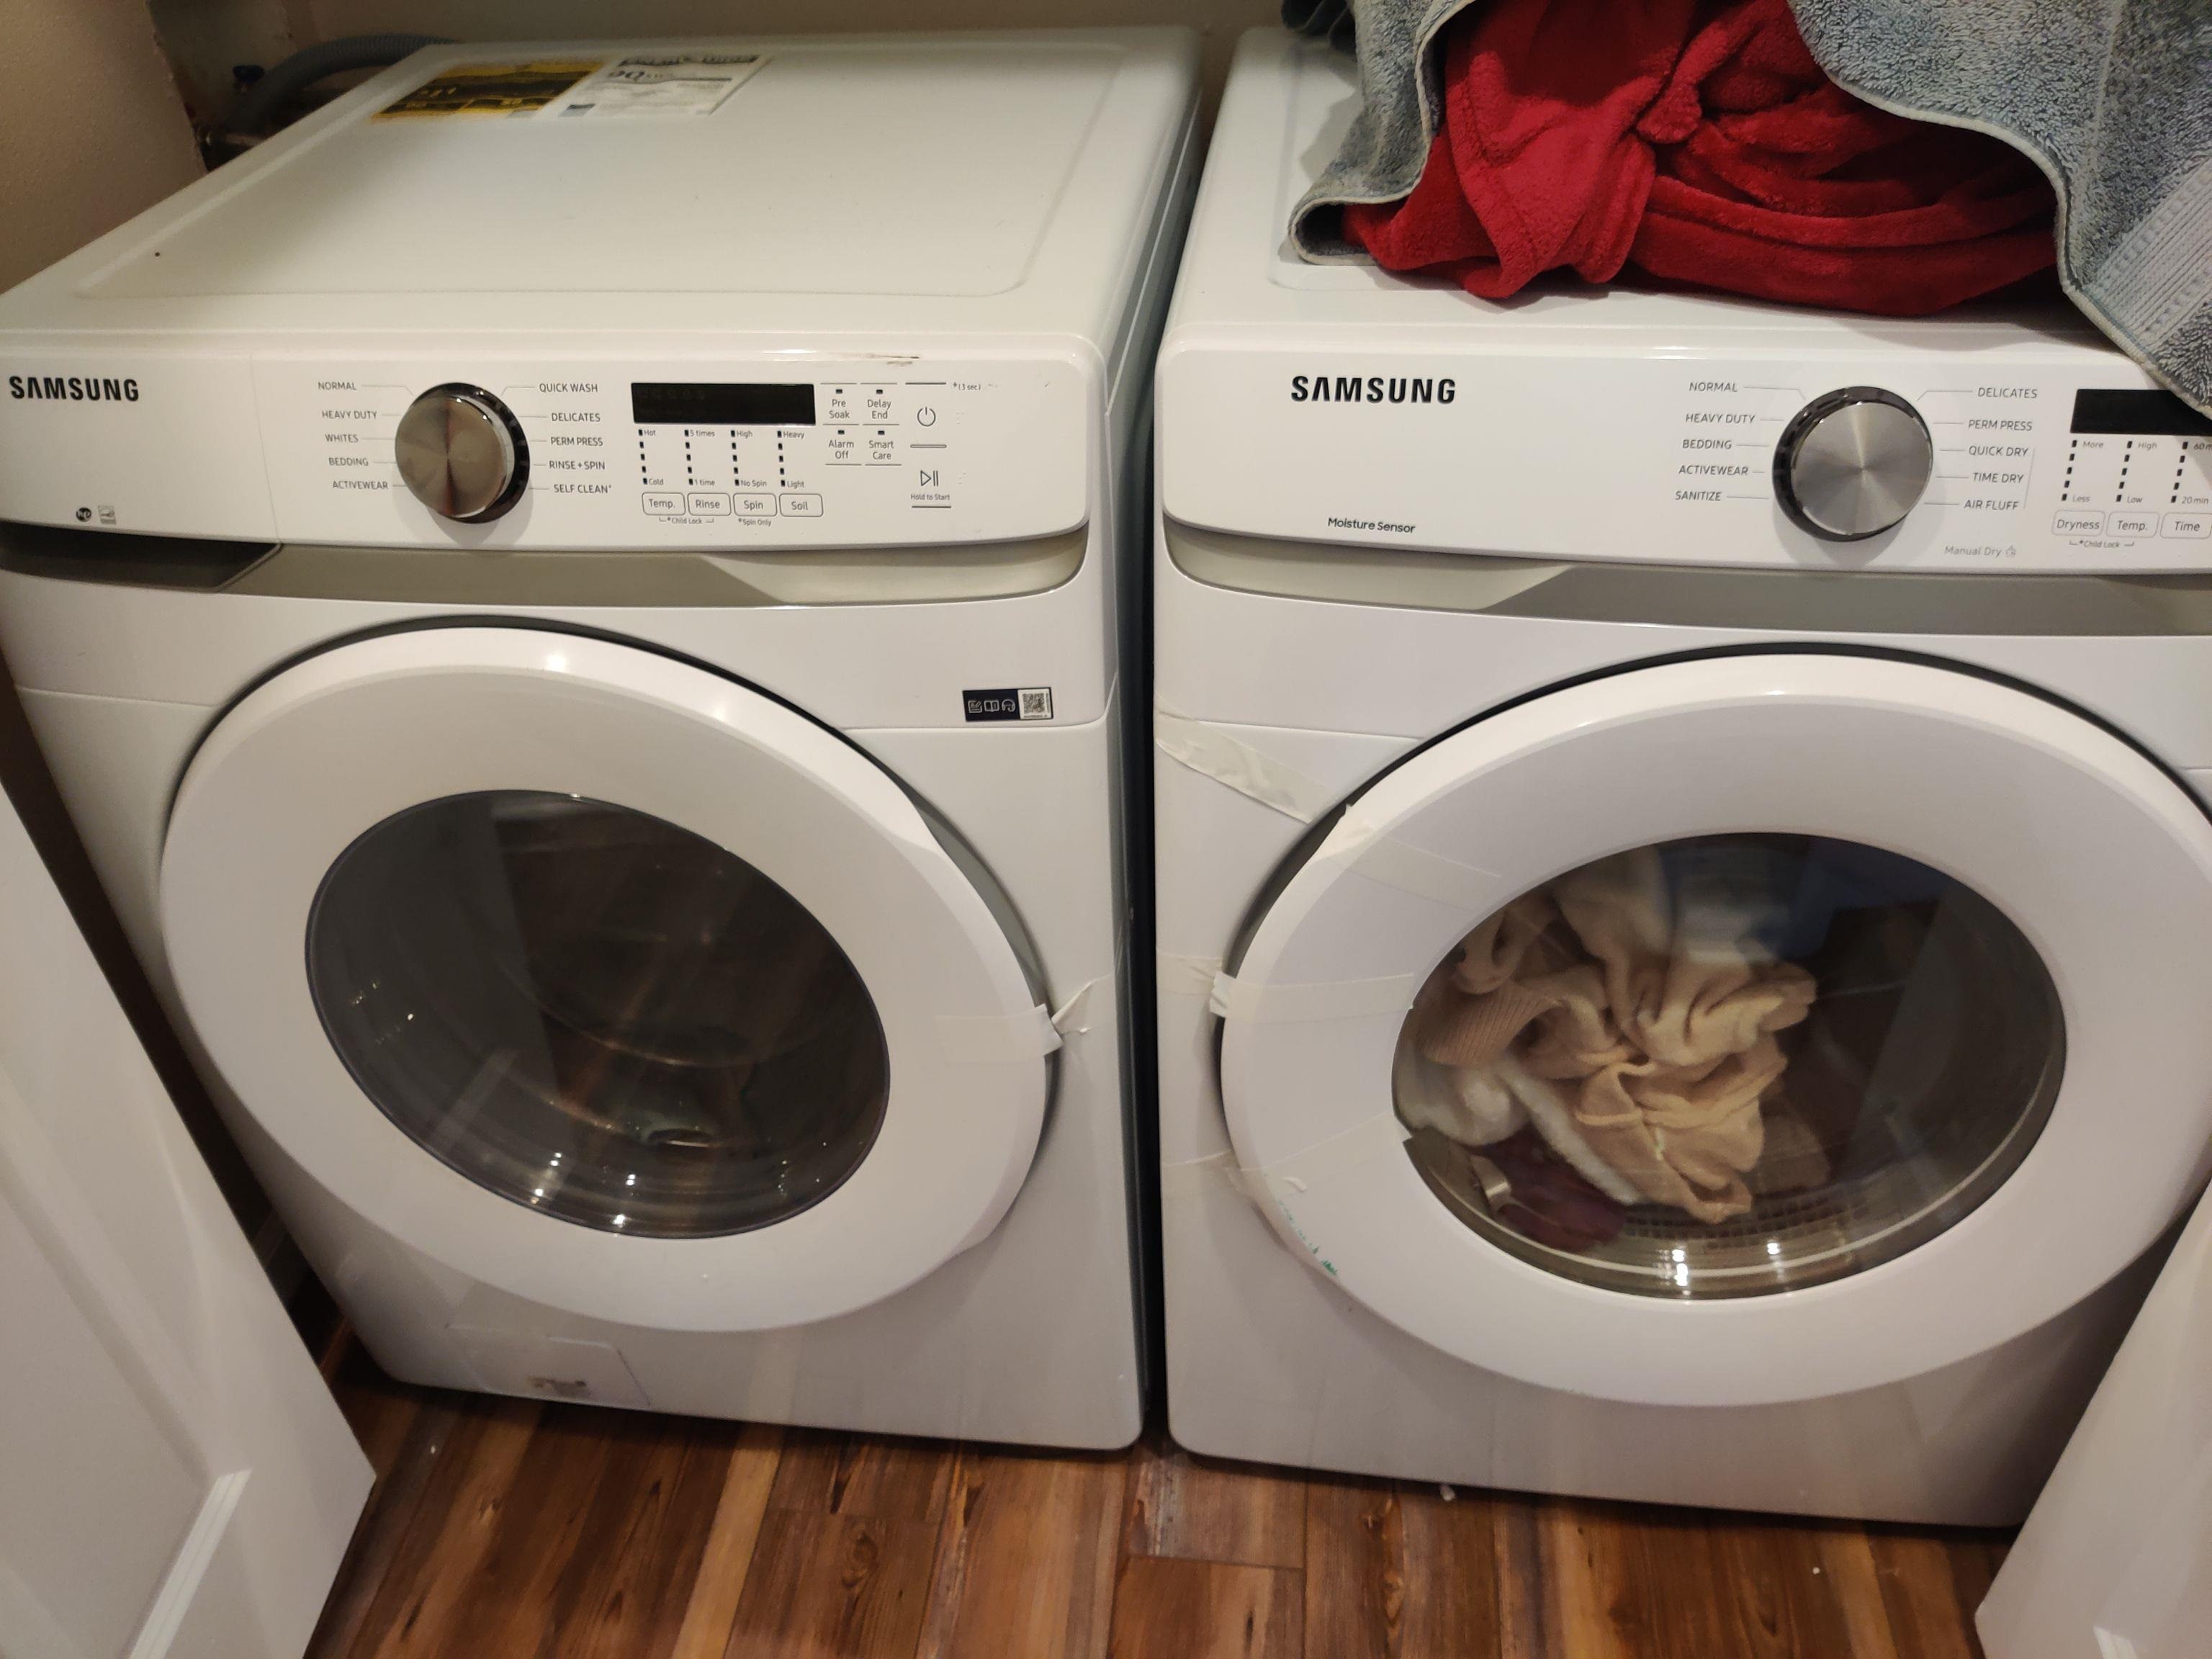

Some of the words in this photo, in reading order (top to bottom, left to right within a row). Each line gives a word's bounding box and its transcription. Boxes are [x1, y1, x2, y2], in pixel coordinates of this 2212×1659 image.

[9, 376, 139, 402] SAMSUNG
[318, 382, 357, 391] NORMAL
[539, 383, 568, 393] QUICK
[570, 384, 598, 393] WASH
[1291, 375, 1456, 404] SAMSUNG
[1689, 382, 1737, 392] NORMAL
[1978, 387, 2038, 399] DELICATES
[867, 400, 891, 409] Delay
[322, 410, 352, 419] HEAVY
[354, 411, 377, 420] DUTY
[552, 413, 601, 423] DELICATES
[1686, 413, 1723, 423] HEAVY
[1725, 414, 1755, 424] DUTY
[1969, 420, 1997, 429] PERM
[2000, 421, 2033, 431] PRESS
[325, 434, 359, 444] WHITES
[550, 437, 573, 446] PERM
[575, 437, 603, 446] PRESS
[1682, 439, 1732, 449] BEDDING
[1969, 446, 2002, 457] QUICK
[2006, 447, 2028, 457] DRY
[2138, 442, 2157, 451] High
[873, 451, 891, 460] Care
[329, 457, 369, 467] BEDDING
[549, 461, 576, 470] RINSE
[583, 462, 606, 470] SPIN
[1678, 465, 1749, 475] ACTIVEWEAR
[1973, 472, 1998, 483] TIME
[2001, 474, 2024, 483] DRY
[333, 481, 388, 490] ACTIVEWEAR
[554, 485, 575, 493] SELF
[787, 480, 804, 489] Light
[1676, 491, 1722, 501] SANITIZE
[649, 499, 675, 509] Temp.
[696, 500, 720, 508] Rinse
[744, 500, 763, 511] Spin
[791, 501, 808, 511] Soil
[1964, 500, 1982, 509] AIR
[1986, 501, 2019, 511] FLUFF
[1328, 518, 1375, 530] Moisture
[1377, 522, 1416, 534] Sensor
[2056, 519, 2100, 531] Dryness
[2118, 520, 2148, 531] Temp.
[2175, 521, 2200, 531] Time
[1944, 546, 1982, 556] Manual
[1984, 547, 2001, 558] Dry
